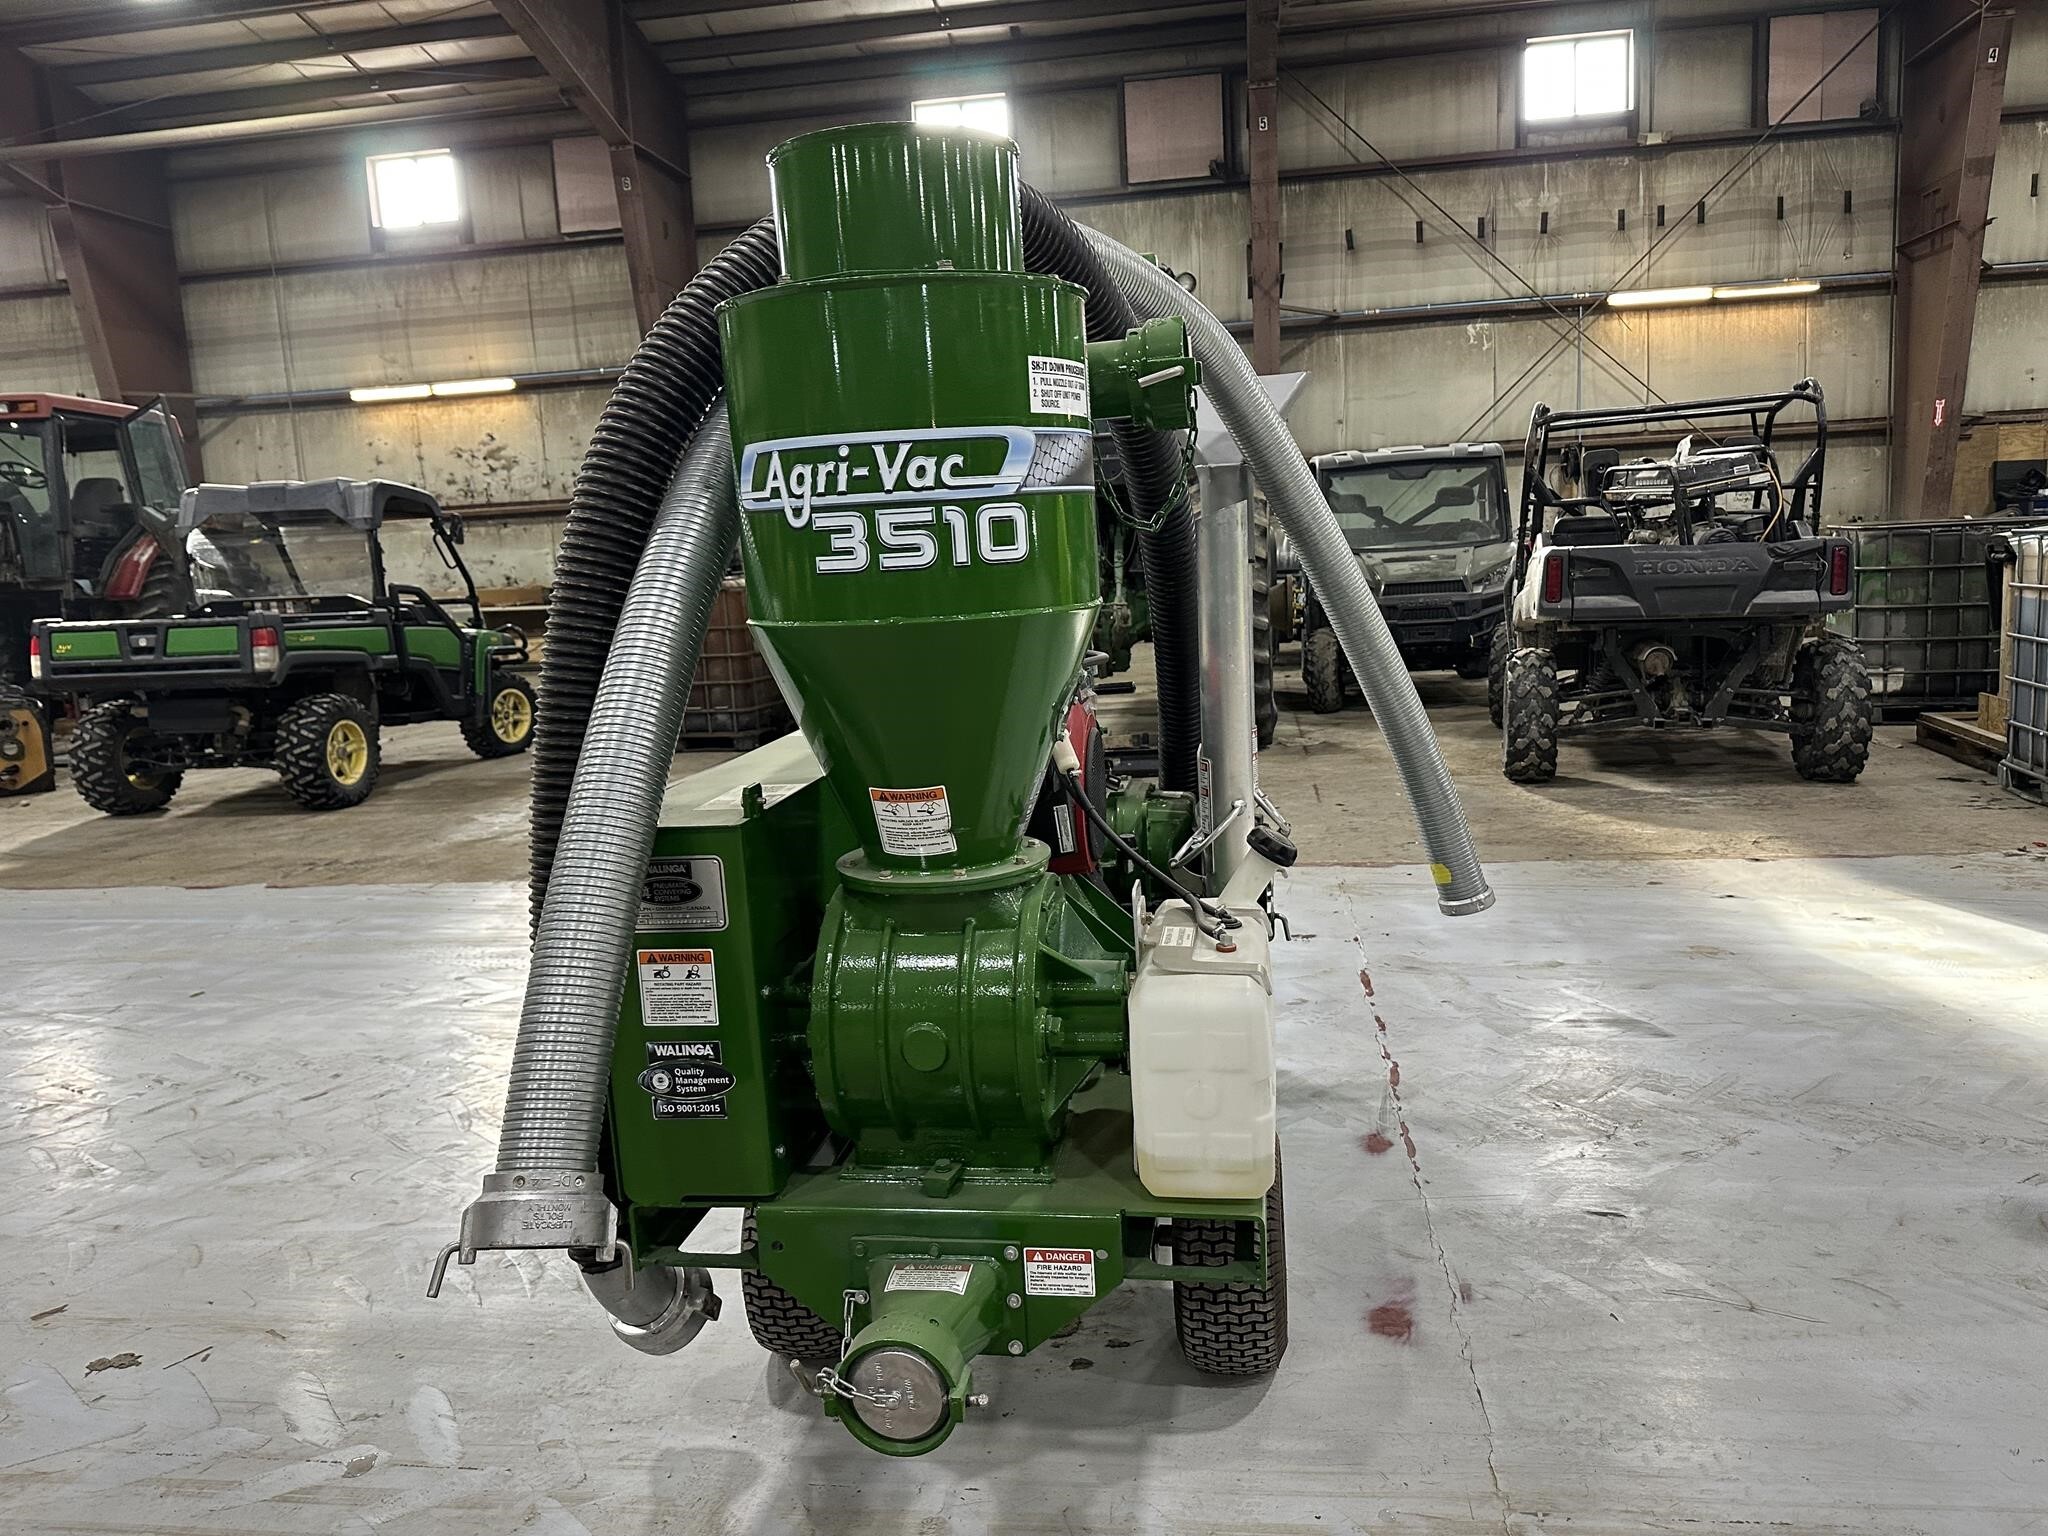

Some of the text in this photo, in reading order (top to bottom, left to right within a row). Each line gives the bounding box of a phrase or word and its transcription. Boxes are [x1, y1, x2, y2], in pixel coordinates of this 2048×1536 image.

[1989, 48, 1997, 61] 4
[1260, 117, 1267, 129] 5
[1031, 360, 1048, 371] SHUT
[1048, 362, 1065, 373] DOWN
[1033, 377, 1038, 386] 1.
[1040, 377, 1053, 386] PULL
[1053, 378, 1067, 388] NOZZLE
[1033, 389, 1038, 397] 2.
[1040, 389, 1053, 398] SHUT
[1053, 390, 1062, 399] OFF
[1062, 391, 1071, 400] UNIT
[760, 442, 968, 529] Agri-Vac
[811, 502, 1031, 575] 3510
[1634, 556, 1759, 577] HONDA
[888, 791, 938, 801] WARNING
[658, 953, 705, 962] WARNING
[654, 1044, 714, 1057] WALINGA
[674, 1068, 705, 1077] Quality
[675, 1077, 730, 1086] Management
[676, 1085, 706, 1094] System
[659, 1104, 721, 1113] ISO 9001:2015
[1046, 1252, 1086, 1262] DANGER
[918, 1263, 963, 1271] DANGER
[1053, 1264, 1082, 1272] HAZARD
